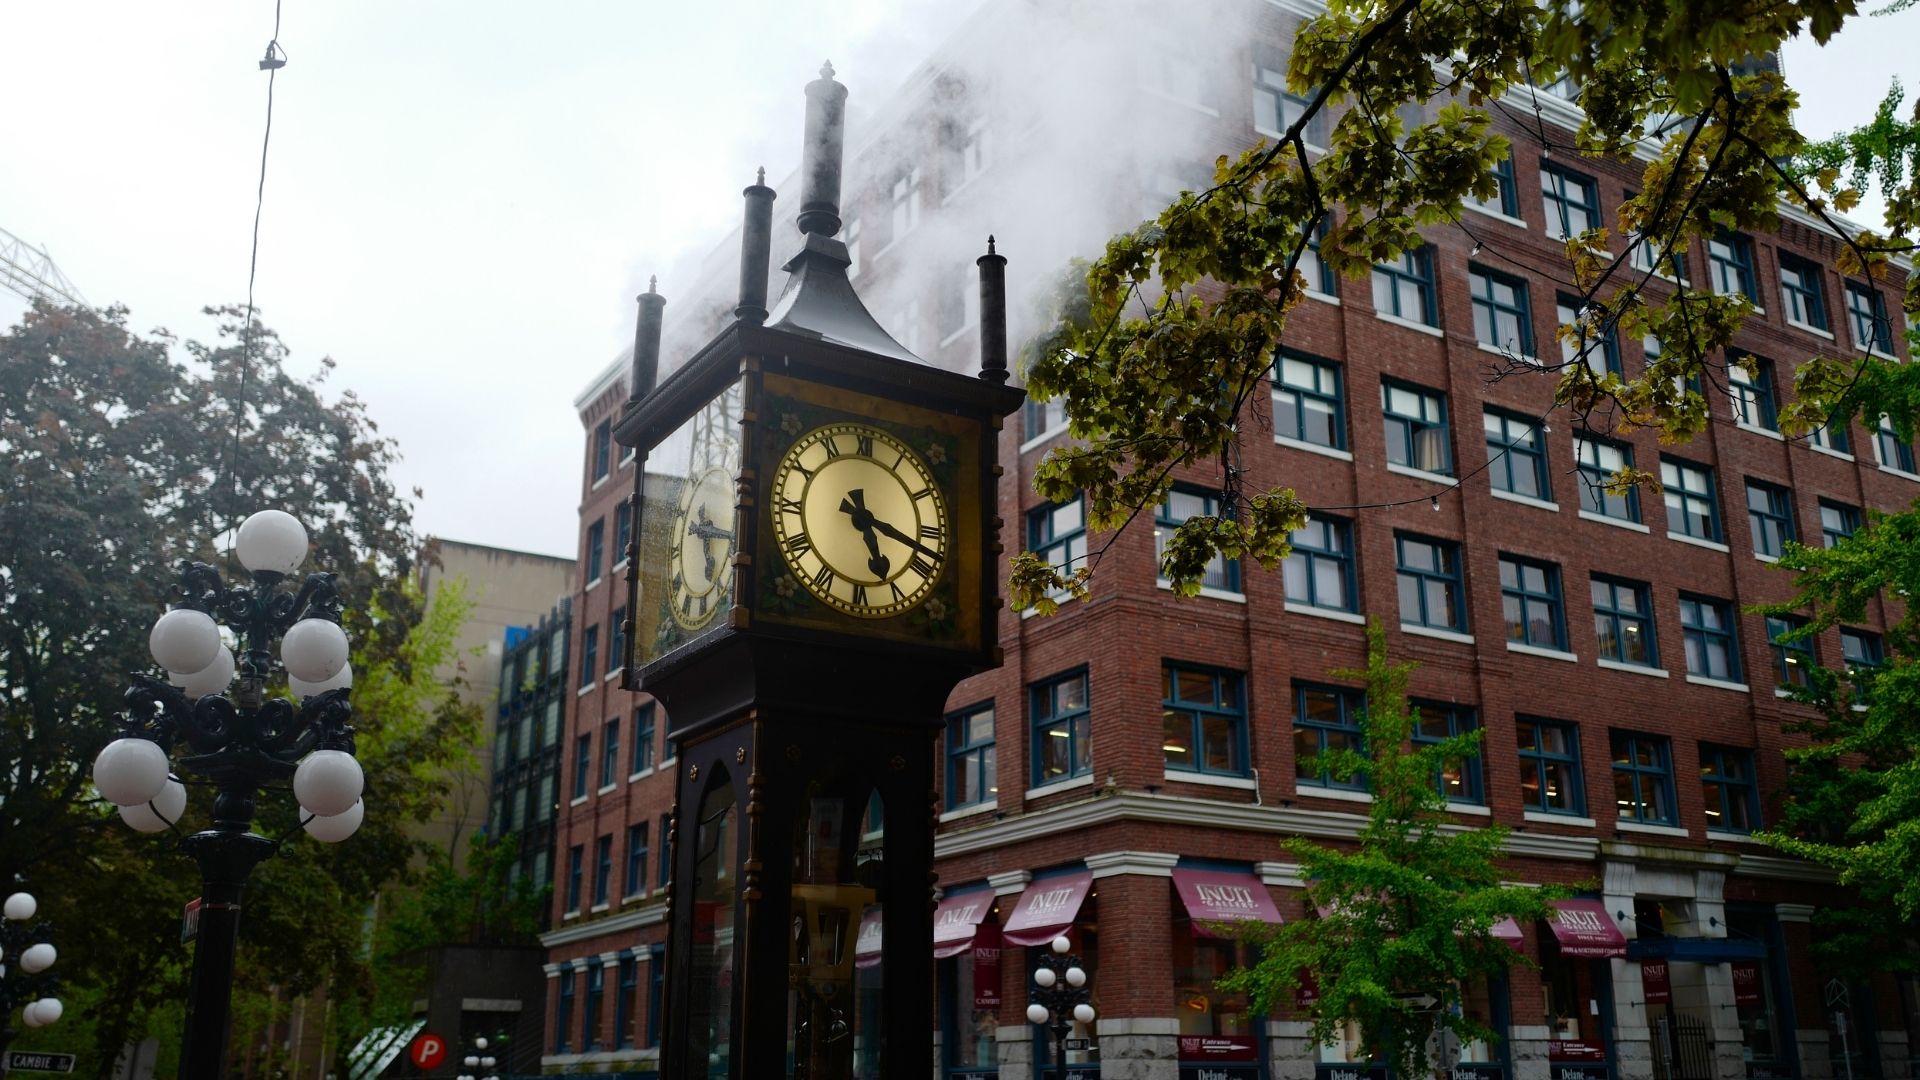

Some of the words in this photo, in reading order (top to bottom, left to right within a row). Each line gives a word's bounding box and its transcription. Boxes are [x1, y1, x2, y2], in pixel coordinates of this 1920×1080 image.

[1028, 888, 1074, 910] INUIT
[1194, 884, 1251, 903] INUIT
[1557, 910, 1601, 925] INUIT
[419, 1040, 439, 1063] P
[13, 1055, 52, 1069] CAMBIE
